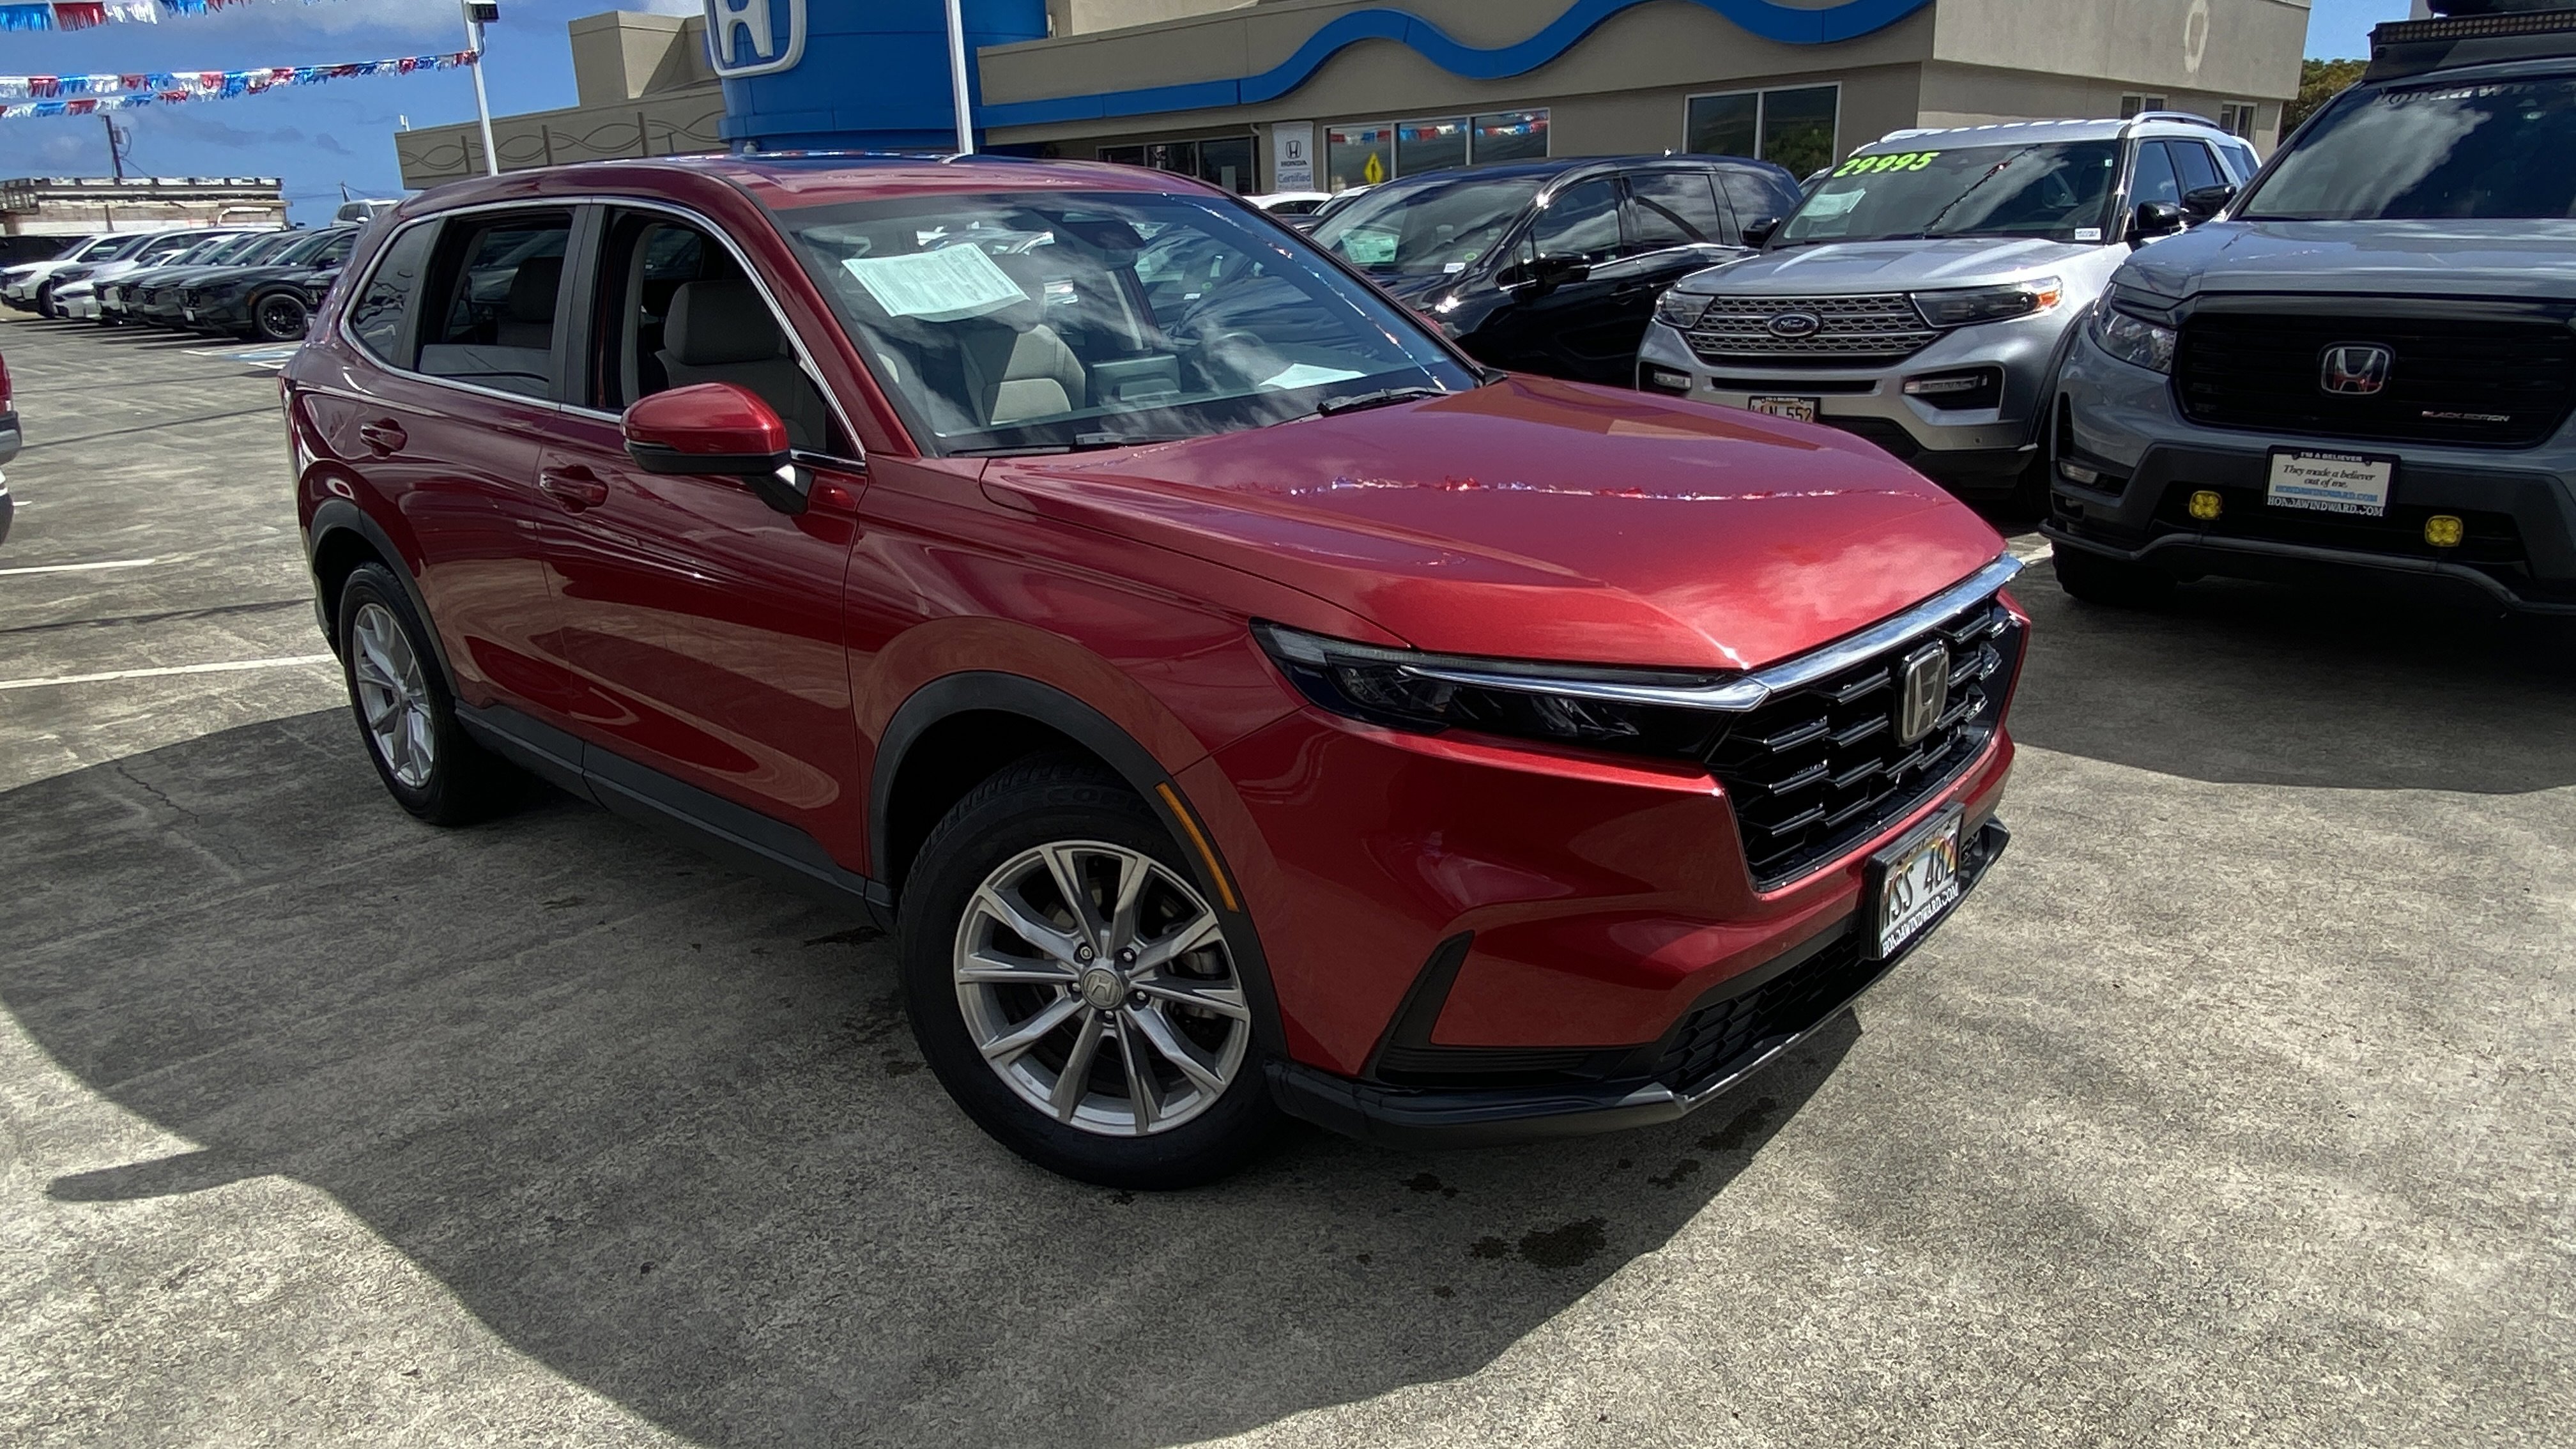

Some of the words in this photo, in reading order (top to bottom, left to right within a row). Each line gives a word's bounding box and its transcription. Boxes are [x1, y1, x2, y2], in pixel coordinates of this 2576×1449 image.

[1832, 152, 1941, 178] 29995
[1278, 171, 1311, 183] Certified
[1786, 406, 1812, 421] 552
[2283, 464, 2304, 476] They
[2306, 467, 2331, 477] made
[2340, 470, 2376, 481] believer
[2320, 477, 2331, 488] of
[2267, 496, 2384, 517] HONDAWINDWARD.COM
[1922, 831, 1957, 894] 482
